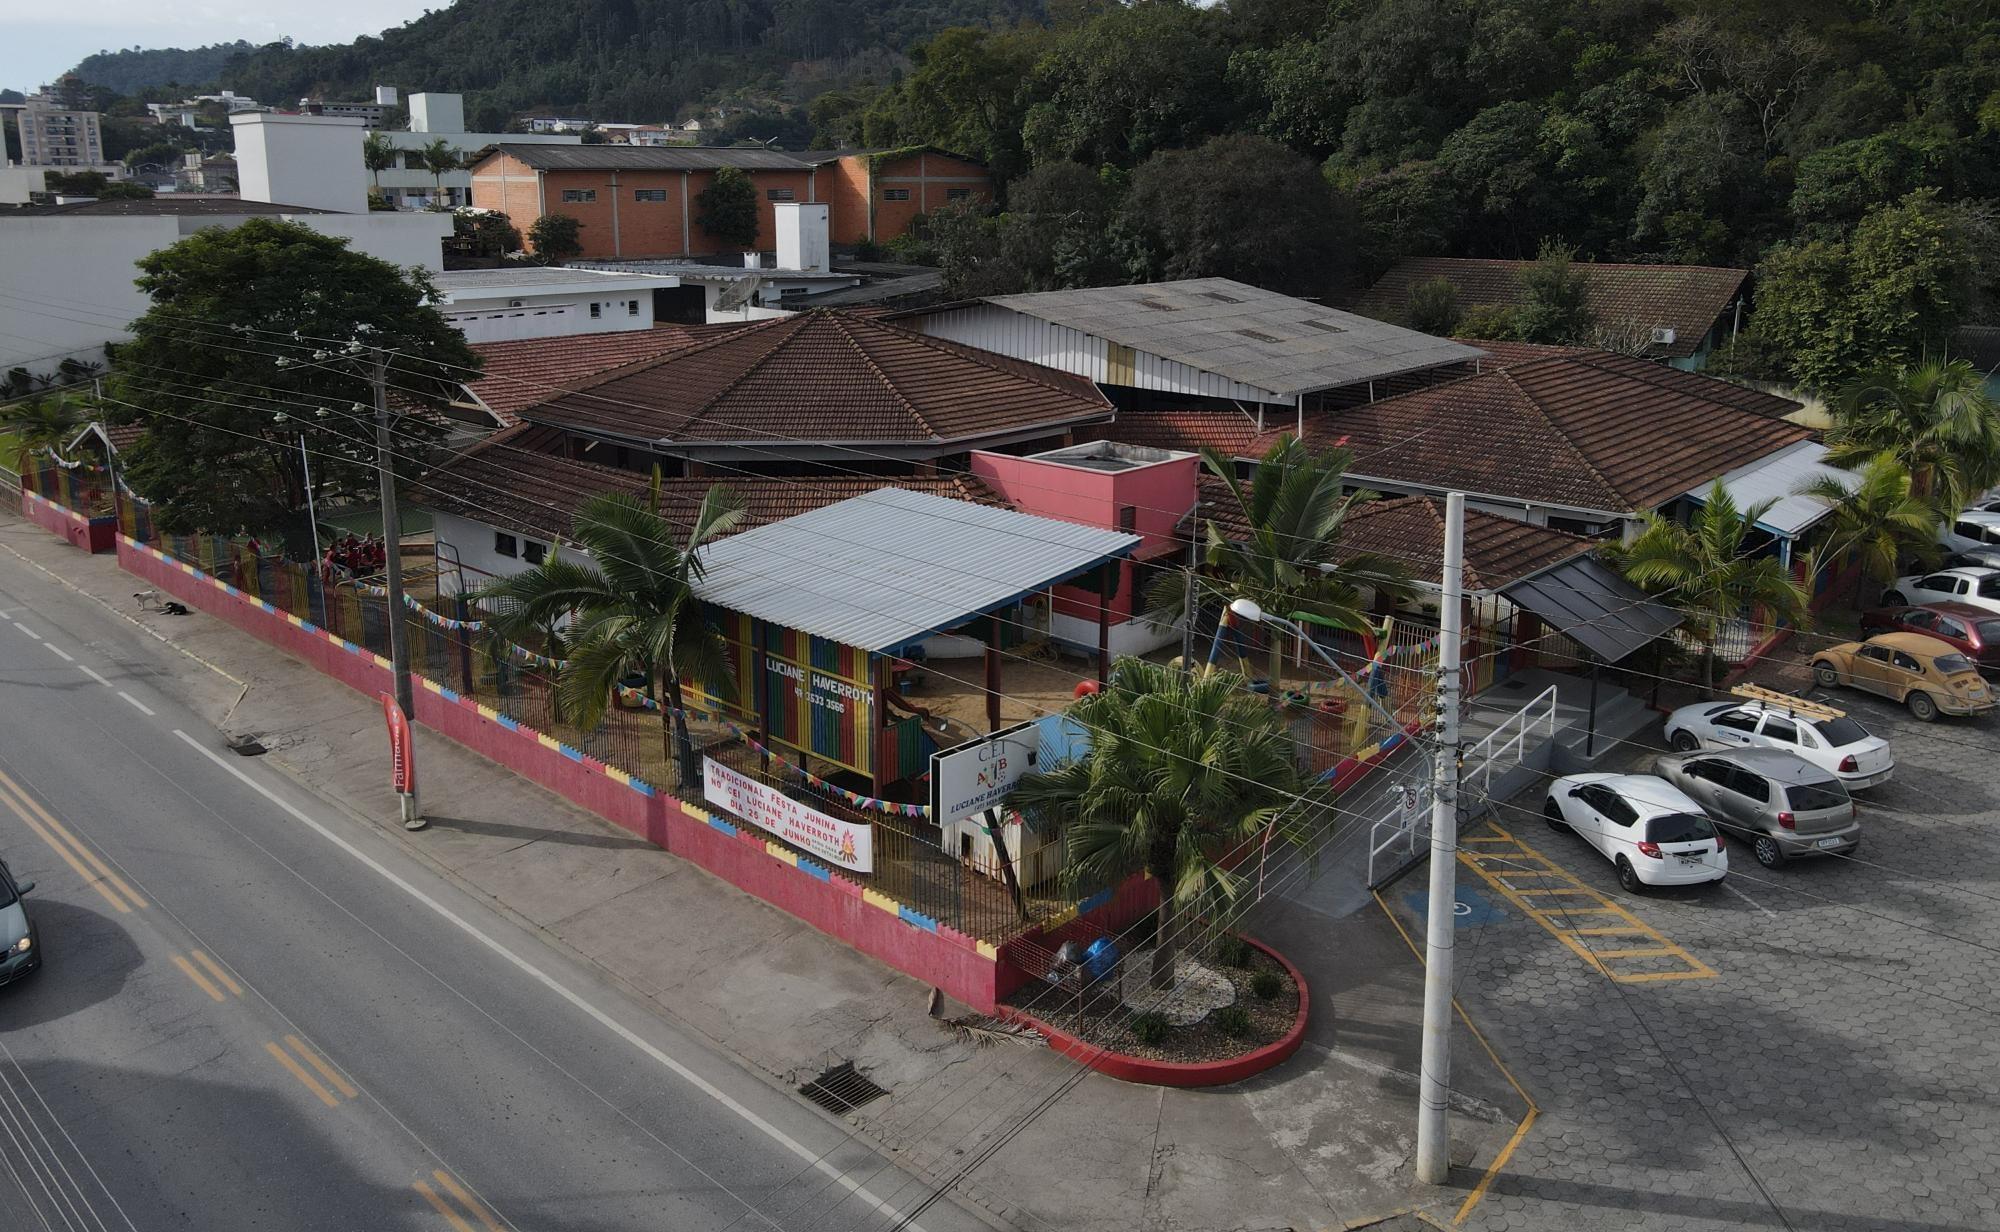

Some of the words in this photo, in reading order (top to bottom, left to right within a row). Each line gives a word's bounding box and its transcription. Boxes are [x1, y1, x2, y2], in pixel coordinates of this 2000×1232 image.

[766, 658, 805, 682] LUCIANE
[812, 674, 875, 706] HAVERROTH
[805, 691, 824, 706] 3533
[826, 699, 845, 714] 3566
[710, 764, 764, 798] TRADICIONAL
[771, 793, 797, 816] FESTA
[804, 811, 836, 833] JUNINA
[711, 777, 722, 789] NO
[727, 786, 741, 799] CEI
[747, 796, 783, 820] LUCIANE
[789, 816, 840, 847] HAVERROTH
[950, 793, 986, 814] LUCIANE
[730, 799, 744, 813] DIA
[748, 808, 759, 820] 25
[765, 816, 776, 828] DE
[783, 828, 811, 847] JUNHO
